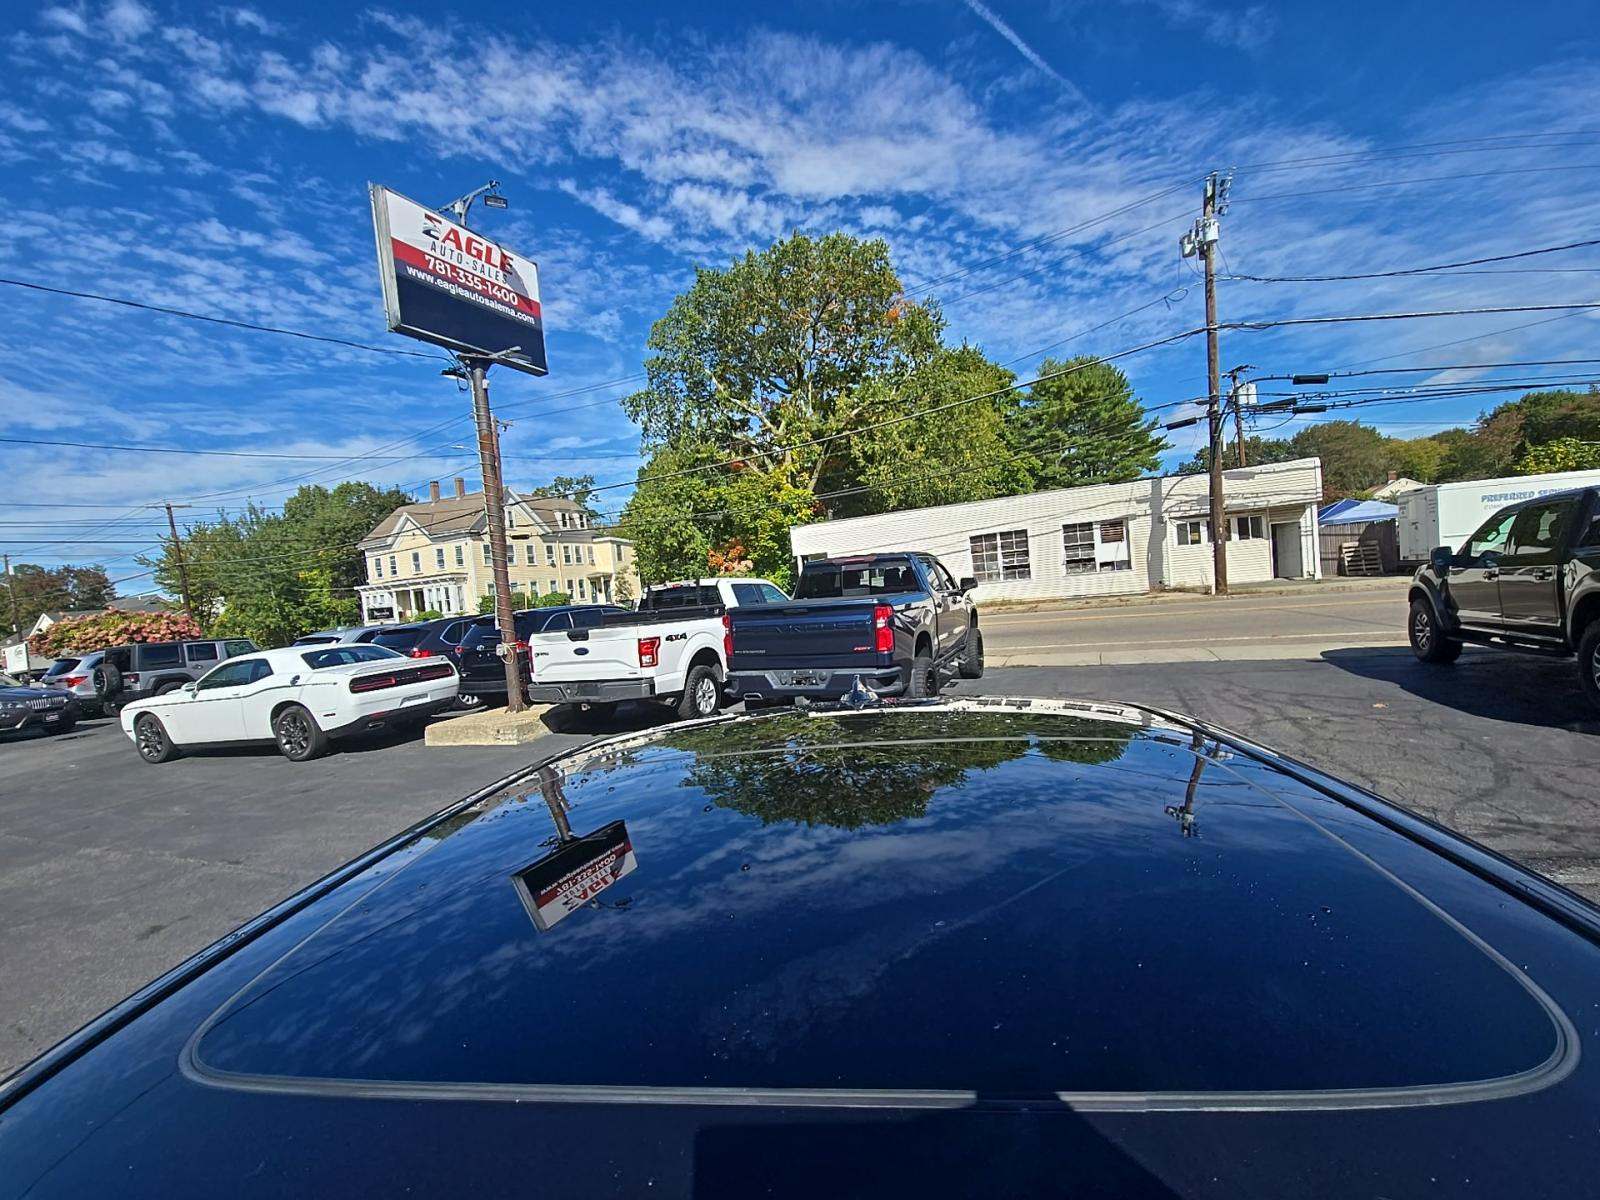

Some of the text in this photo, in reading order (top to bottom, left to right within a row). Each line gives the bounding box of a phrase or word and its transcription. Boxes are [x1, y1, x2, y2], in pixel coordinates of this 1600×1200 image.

[422, 213, 514, 276] EAGLE
[425, 254, 518, 306] 781-335-1400
[1481, 490, 1535, 502] PREFERRED
